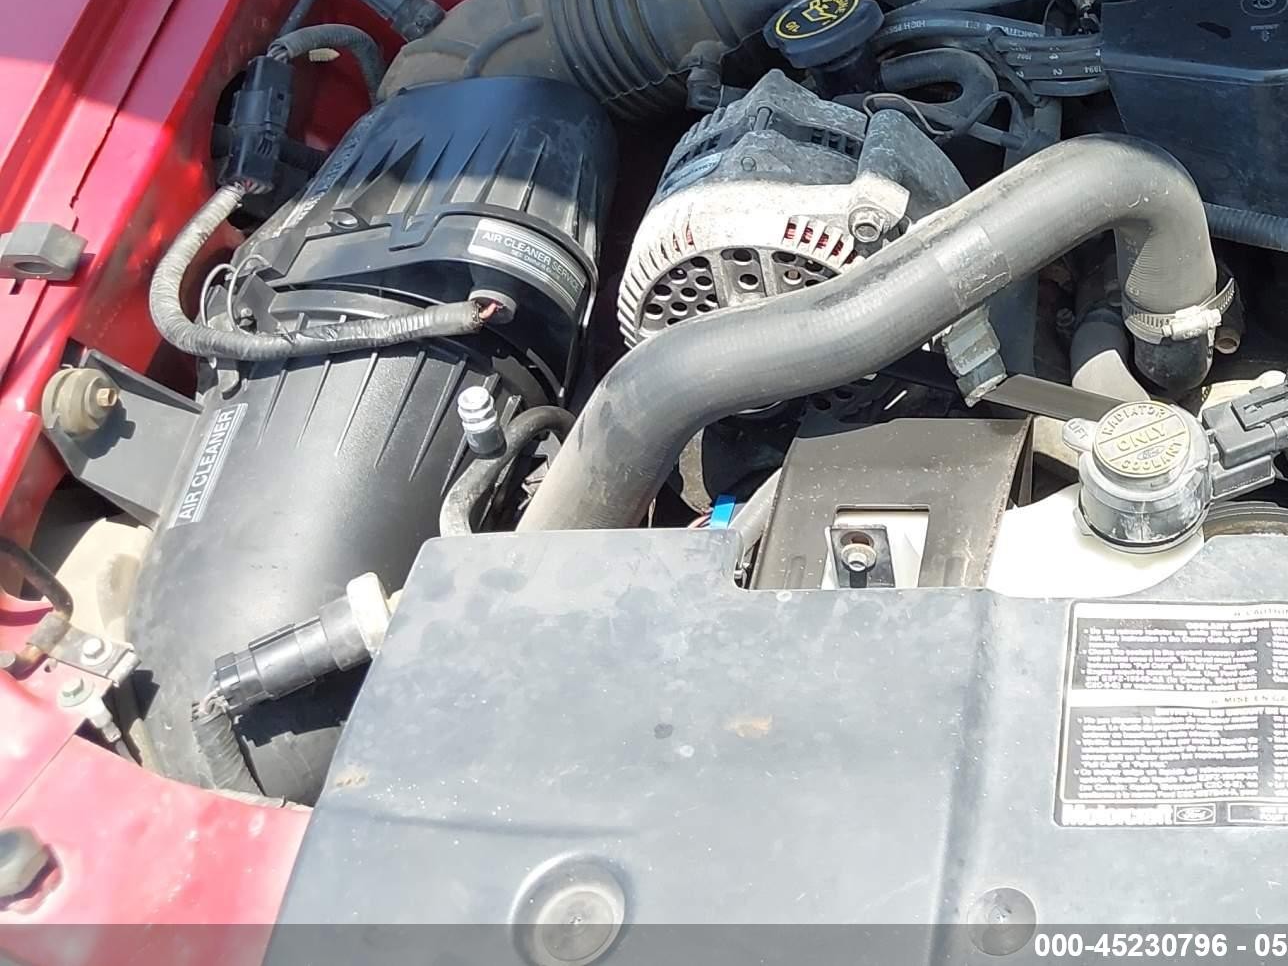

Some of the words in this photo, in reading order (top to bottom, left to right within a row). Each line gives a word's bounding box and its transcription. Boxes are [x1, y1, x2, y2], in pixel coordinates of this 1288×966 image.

[785, 20, 801, 33] OIL
[481, 231, 502, 244] AIR
[503, 237, 551, 265] CLEANER
[551, 260, 579, 292] SERVICE
[1067, 421, 1089, 440] LIFT
[1101, 405, 1167, 436] RADIATOR
[1117, 423, 1167, 452] ONLY
[178, 491, 202, 520] AIR
[191, 409, 236, 488] CLEANER
[1121, 442, 1183, 471] COOLANT
